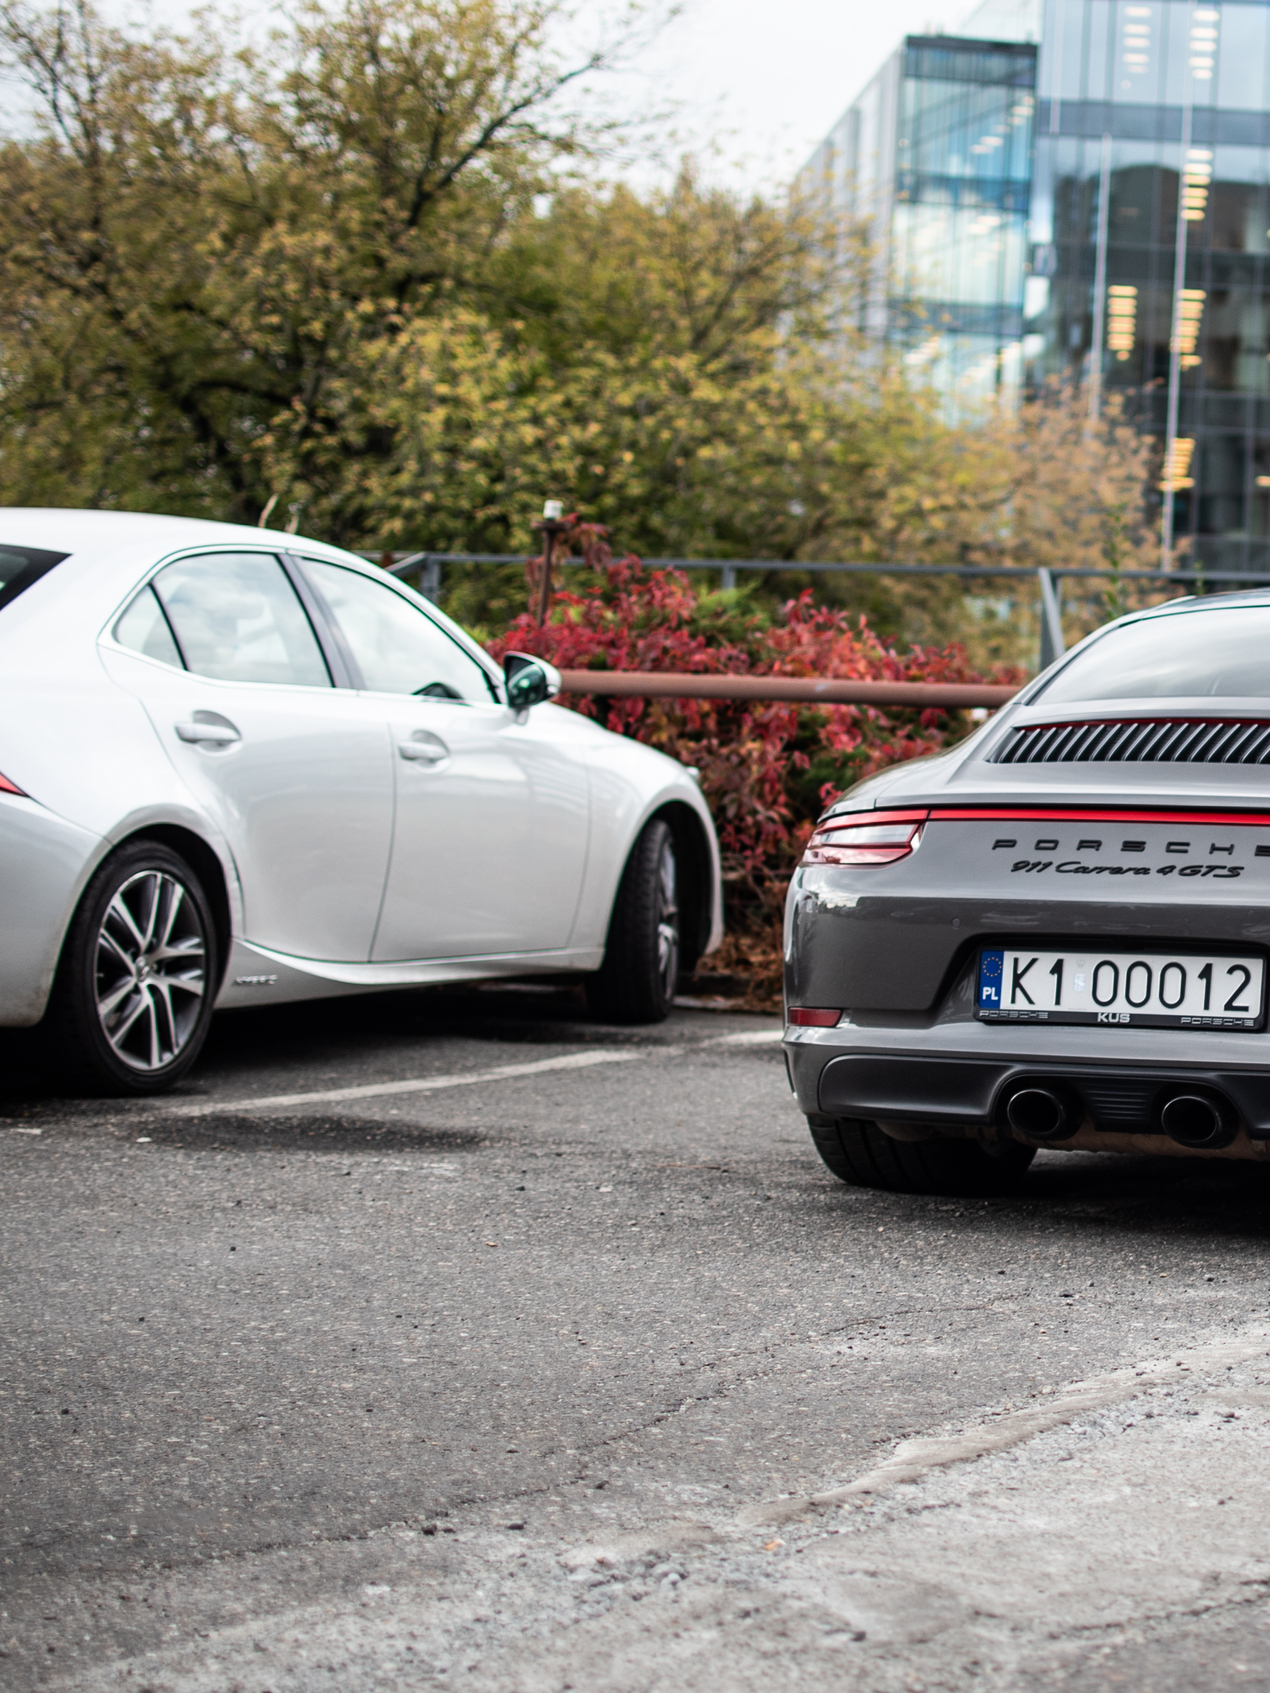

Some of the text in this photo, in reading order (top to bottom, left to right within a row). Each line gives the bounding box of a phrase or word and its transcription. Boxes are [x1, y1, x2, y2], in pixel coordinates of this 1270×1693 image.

[1010, 860, 1053, 873] 911
[1055, 860, 1150, 876] Carrera
[982, 986, 999, 1001] PL
[1092, 959, 1252, 1013] 00012
[979, 1010, 1254, 1026] PORSCHE KUS PORSCHE
